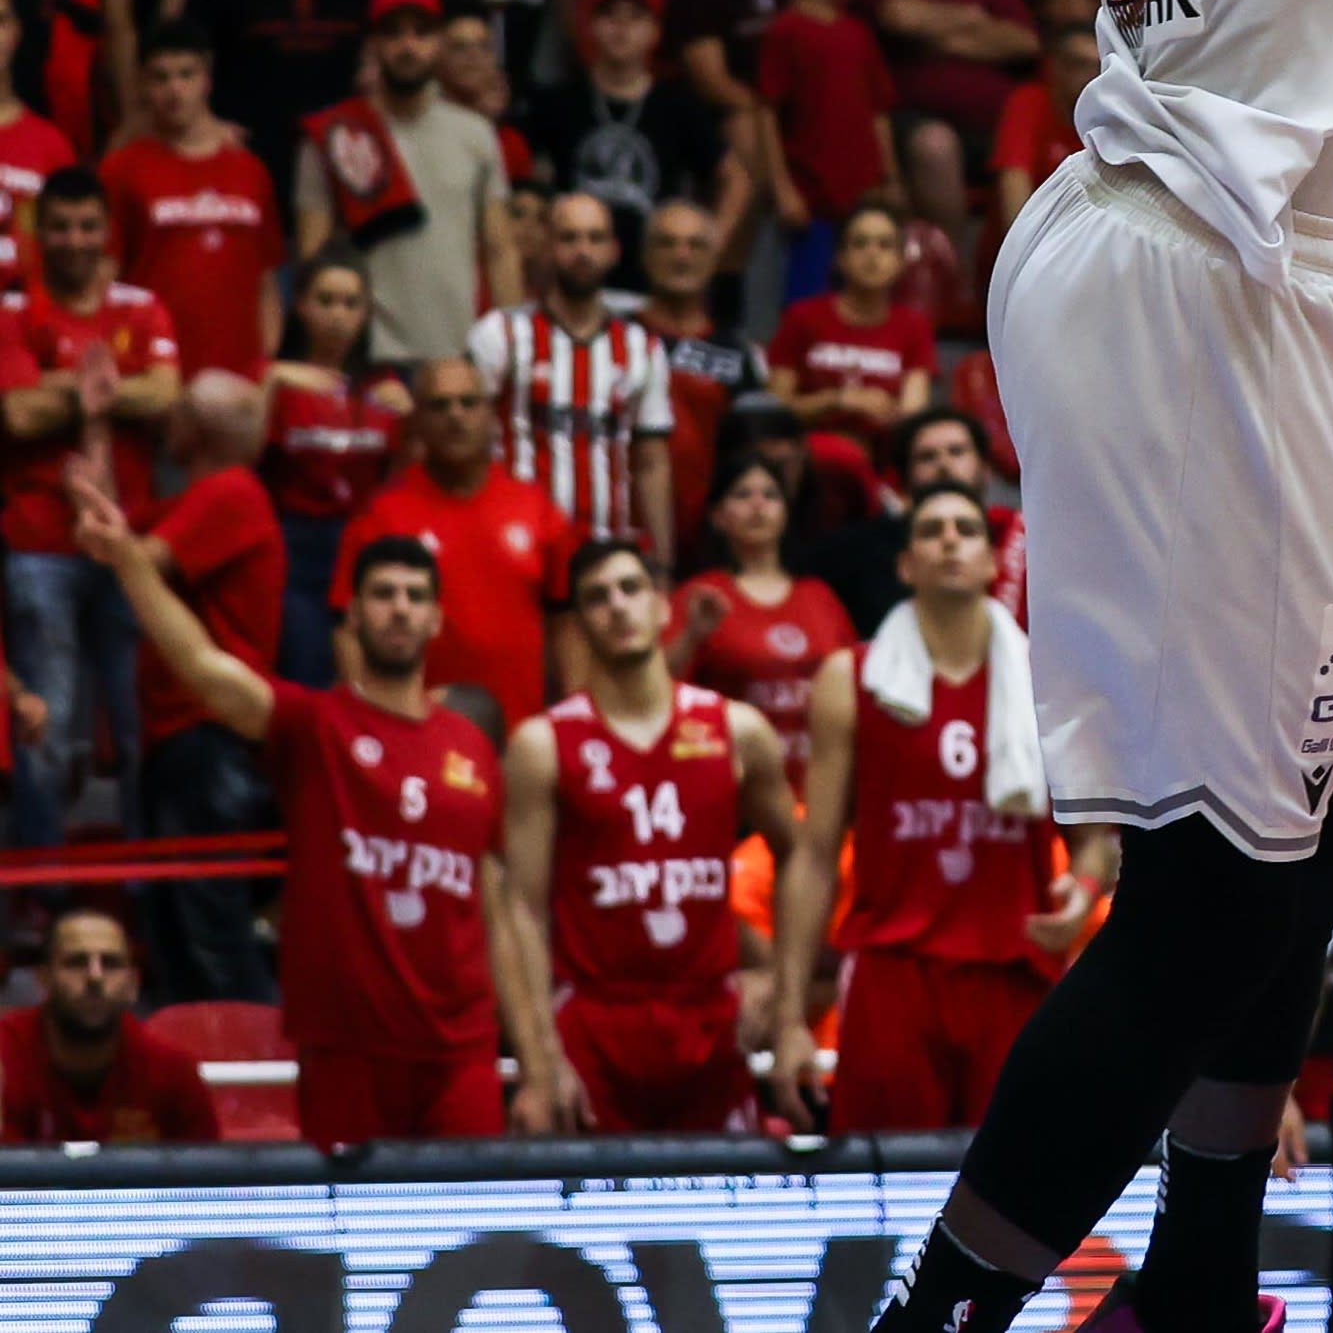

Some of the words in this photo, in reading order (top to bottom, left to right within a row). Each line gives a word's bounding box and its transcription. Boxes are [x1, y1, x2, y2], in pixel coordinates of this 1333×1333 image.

[938, 719, 979, 780] 6
[401, 776, 428, 822] 5
[622, 781, 686, 844] 14
